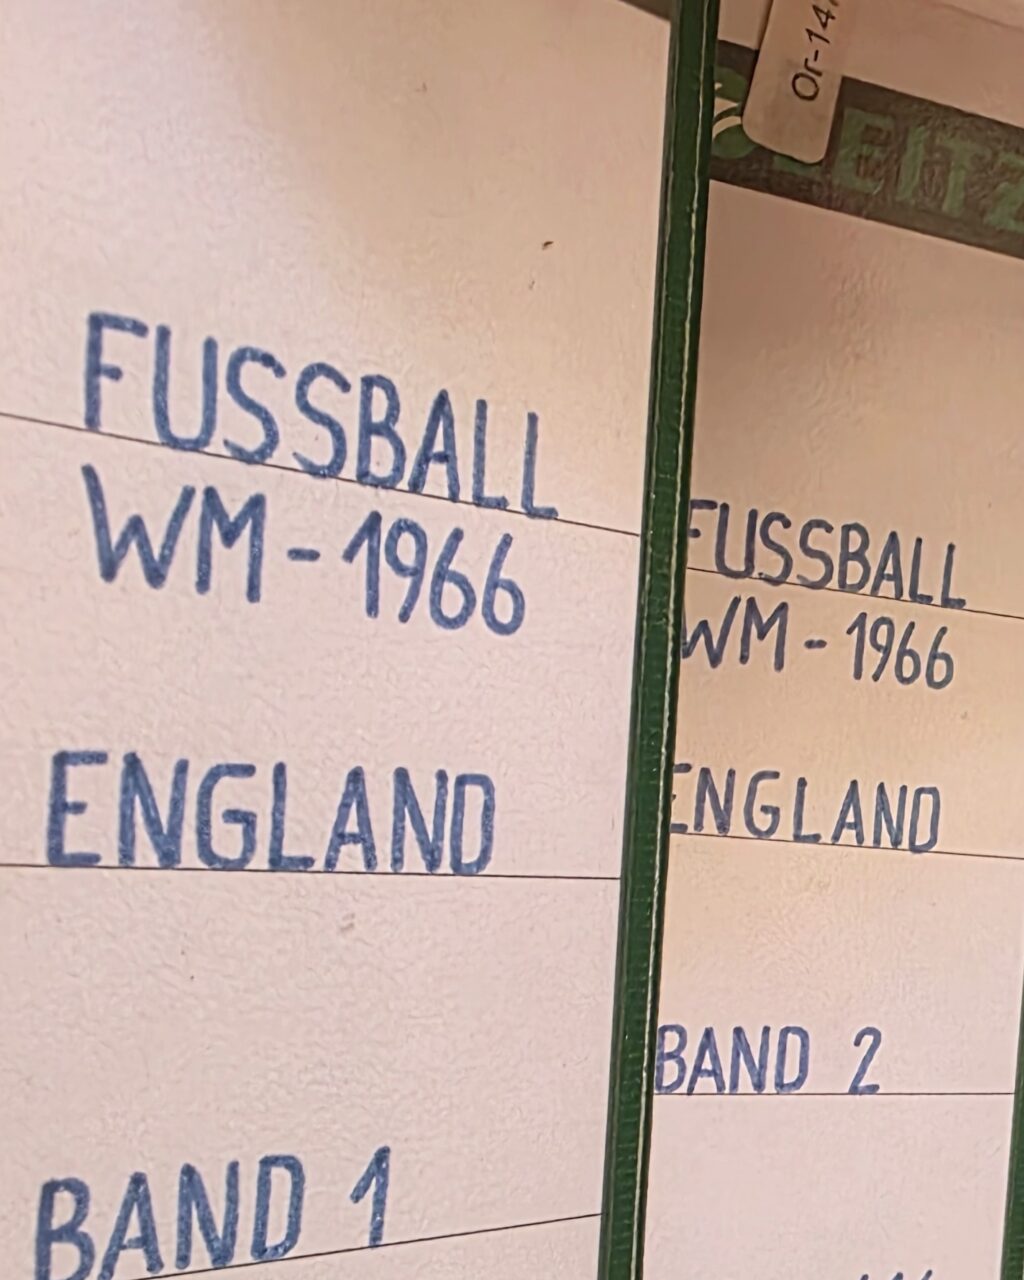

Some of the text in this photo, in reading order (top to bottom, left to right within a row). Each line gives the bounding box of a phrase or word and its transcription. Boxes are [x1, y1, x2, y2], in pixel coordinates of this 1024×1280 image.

[83, 310, 560, 520] FUSSBALL
[687, 499, 967, 609] FUSSBALL
[46, 749, 497, 876] ENGLAND
[654, 1023, 884, 1096] BAND 2
[349, 1144, 391, 1249] 1
